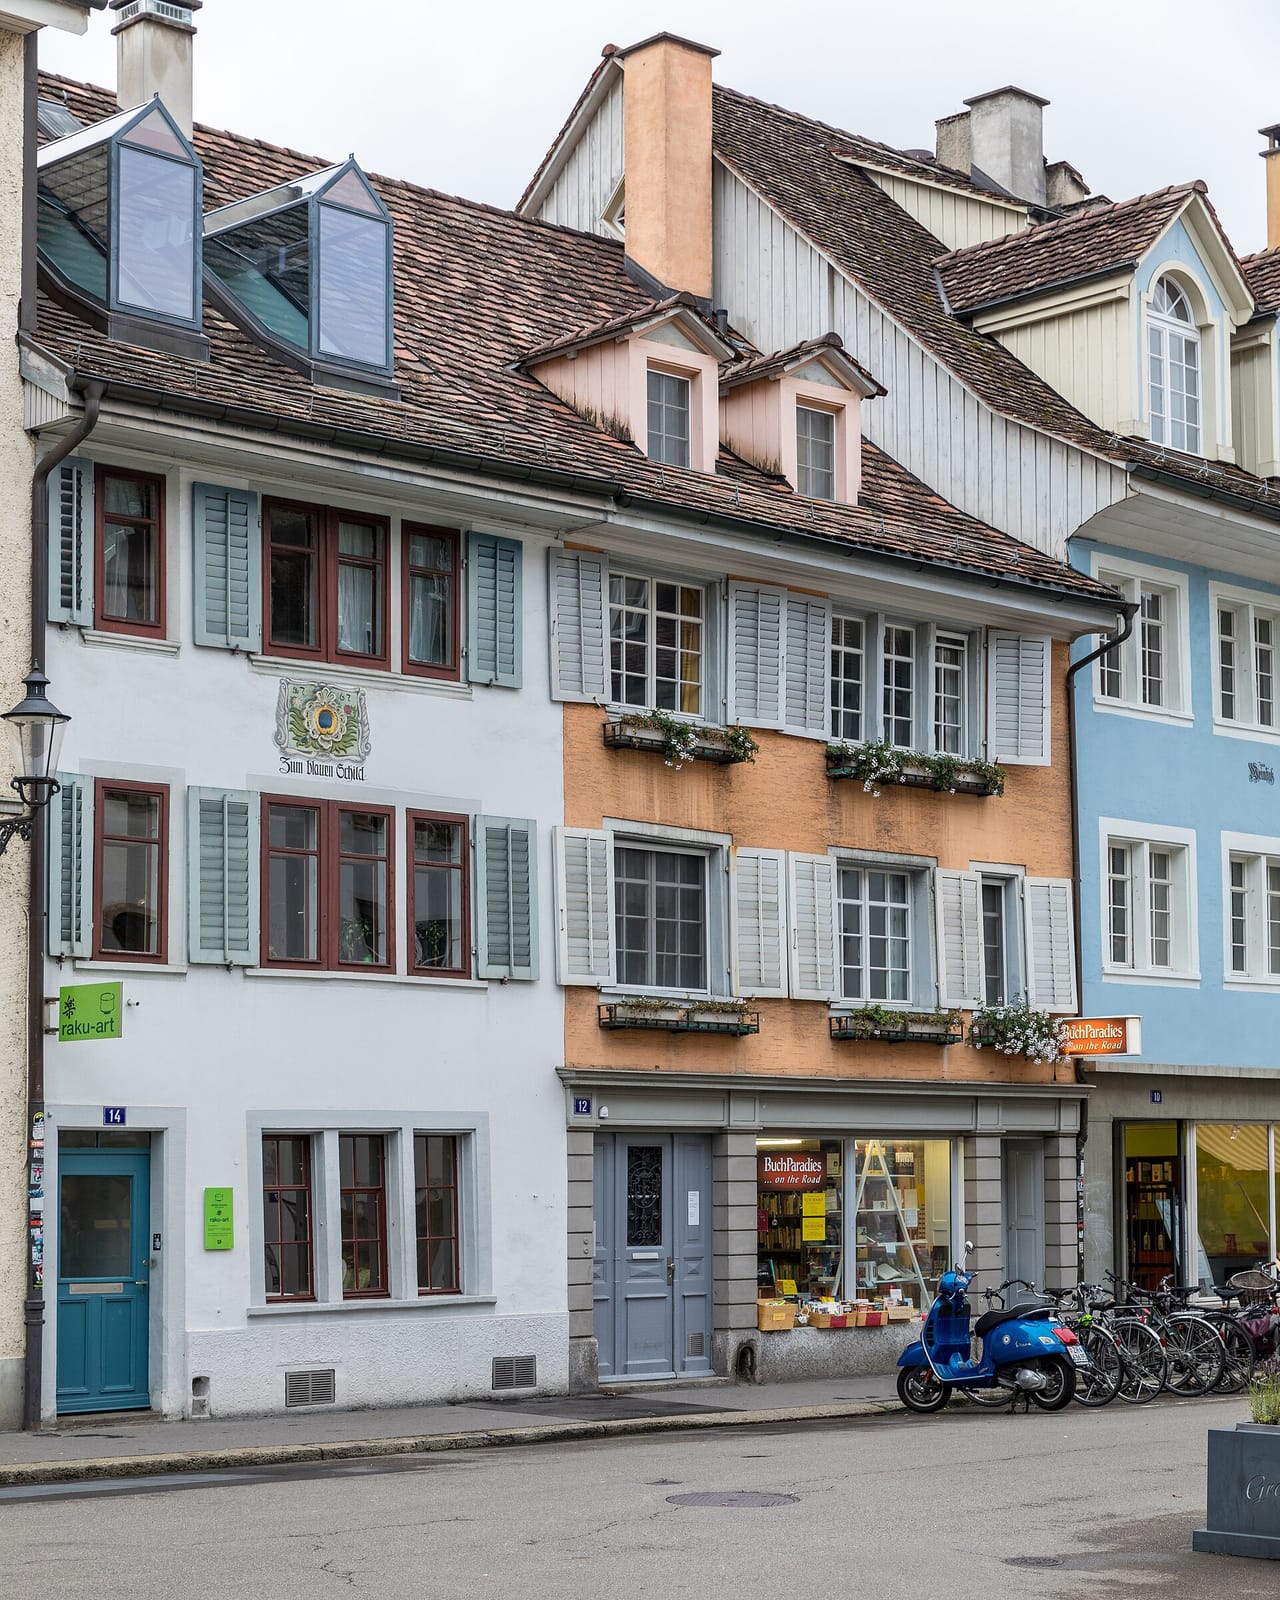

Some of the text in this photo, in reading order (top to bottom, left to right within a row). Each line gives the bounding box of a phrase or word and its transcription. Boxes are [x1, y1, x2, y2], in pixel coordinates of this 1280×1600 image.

[279, 756, 365, 781] Zum blauen Schild
[61, 1017, 115, 1036] raku-art
[1086, 1041, 1098, 1050] the
[1101, 1040, 1122, 1049] Road
[578, 1100, 588, 1112] 12
[109, 1109, 120, 1123] 14
[764, 1156, 822, 1172] BuchParadies
[787, 1175, 799, 1184] the
[801, 1174, 821, 1184] Road
